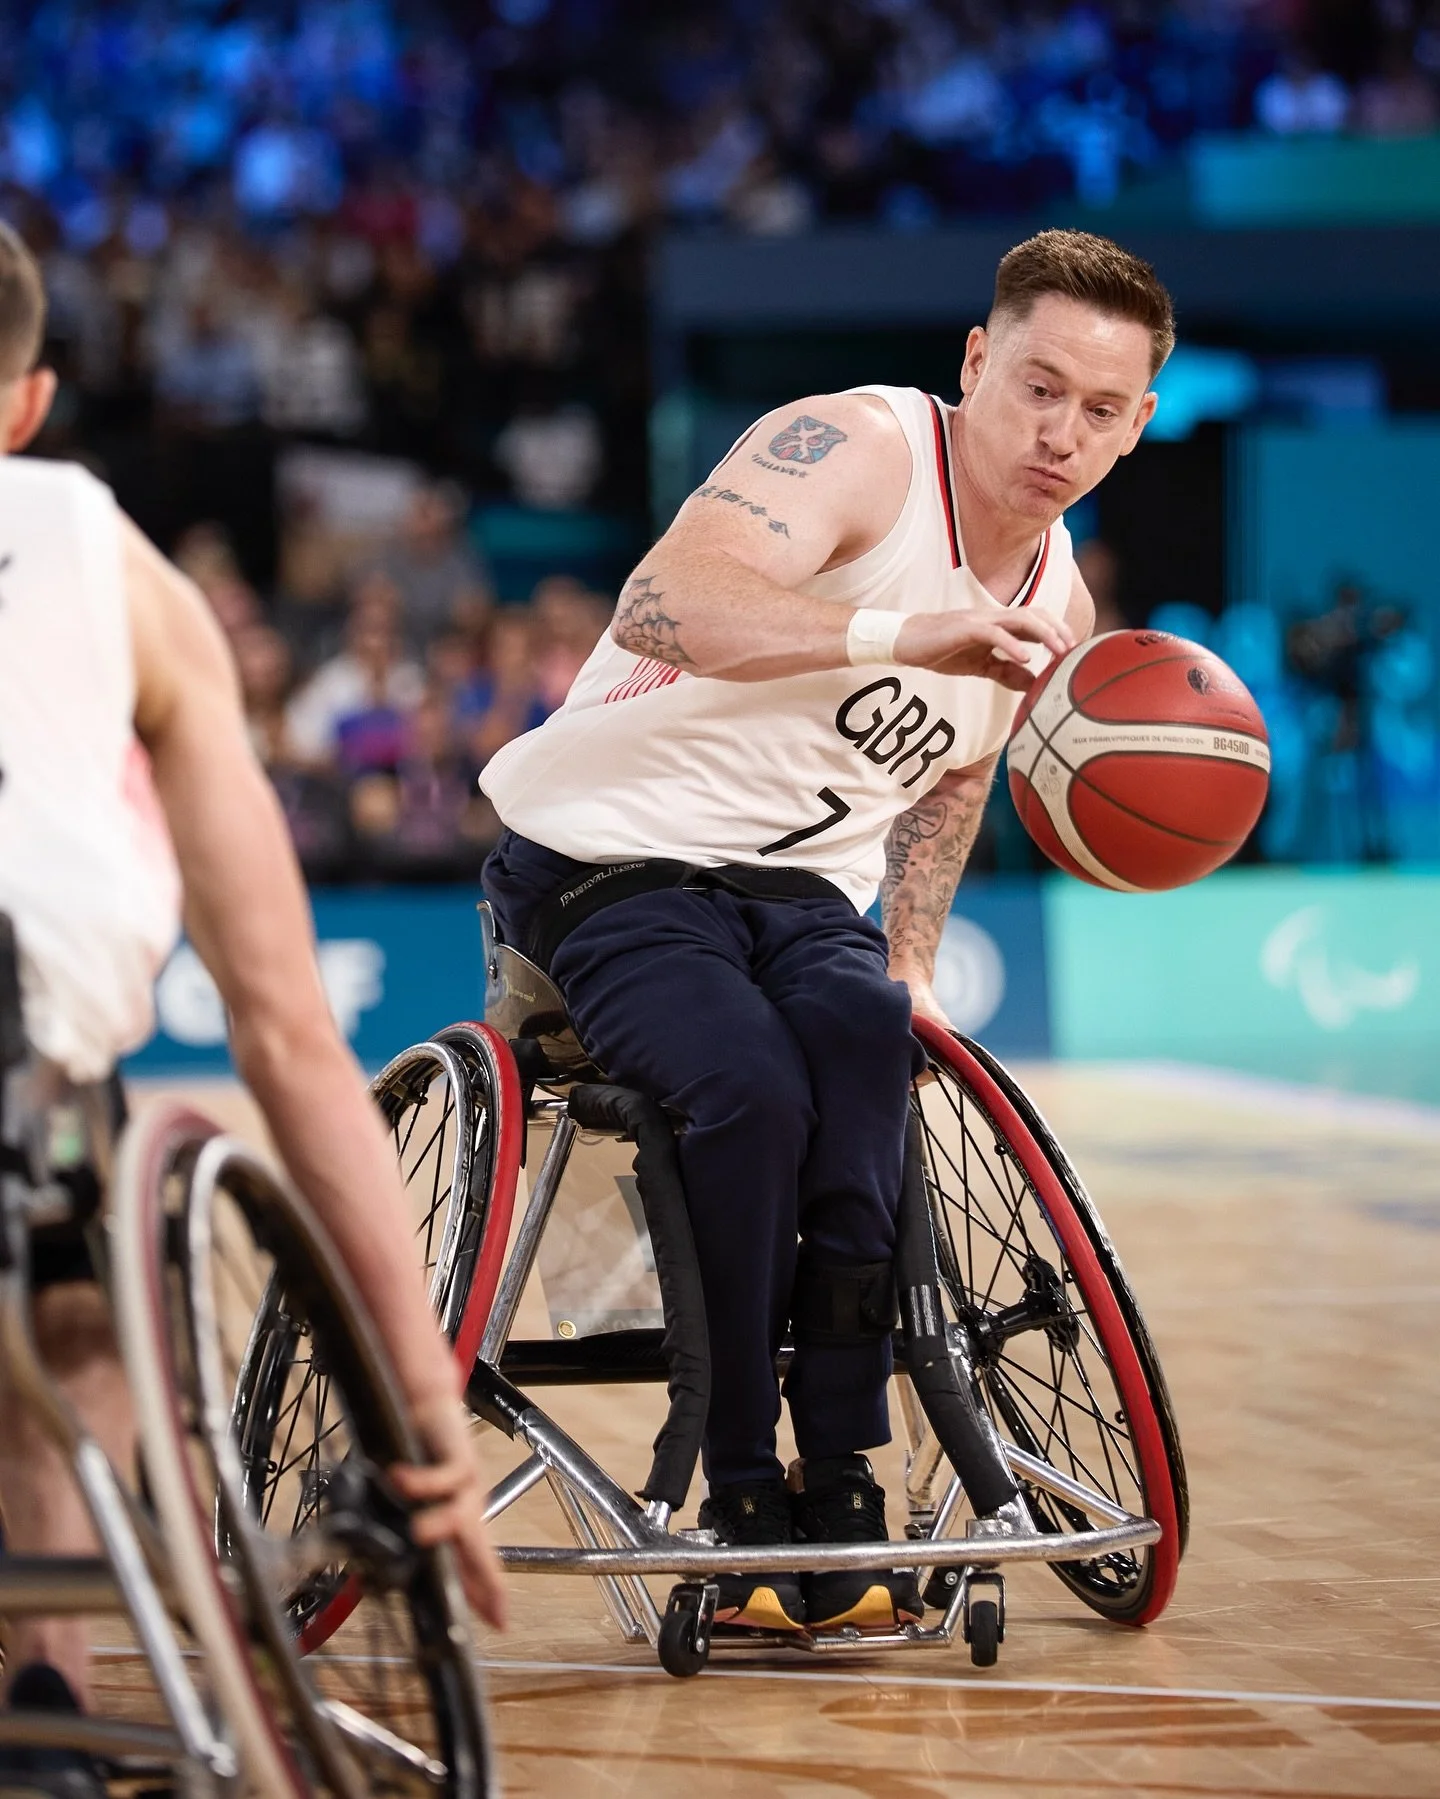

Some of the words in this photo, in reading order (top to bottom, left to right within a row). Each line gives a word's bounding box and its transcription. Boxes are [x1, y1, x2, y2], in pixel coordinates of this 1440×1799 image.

[835, 676, 956, 789] GBR
[1213, 736, 1249, 755] BG4500
[756, 786, 852, 857] 7
